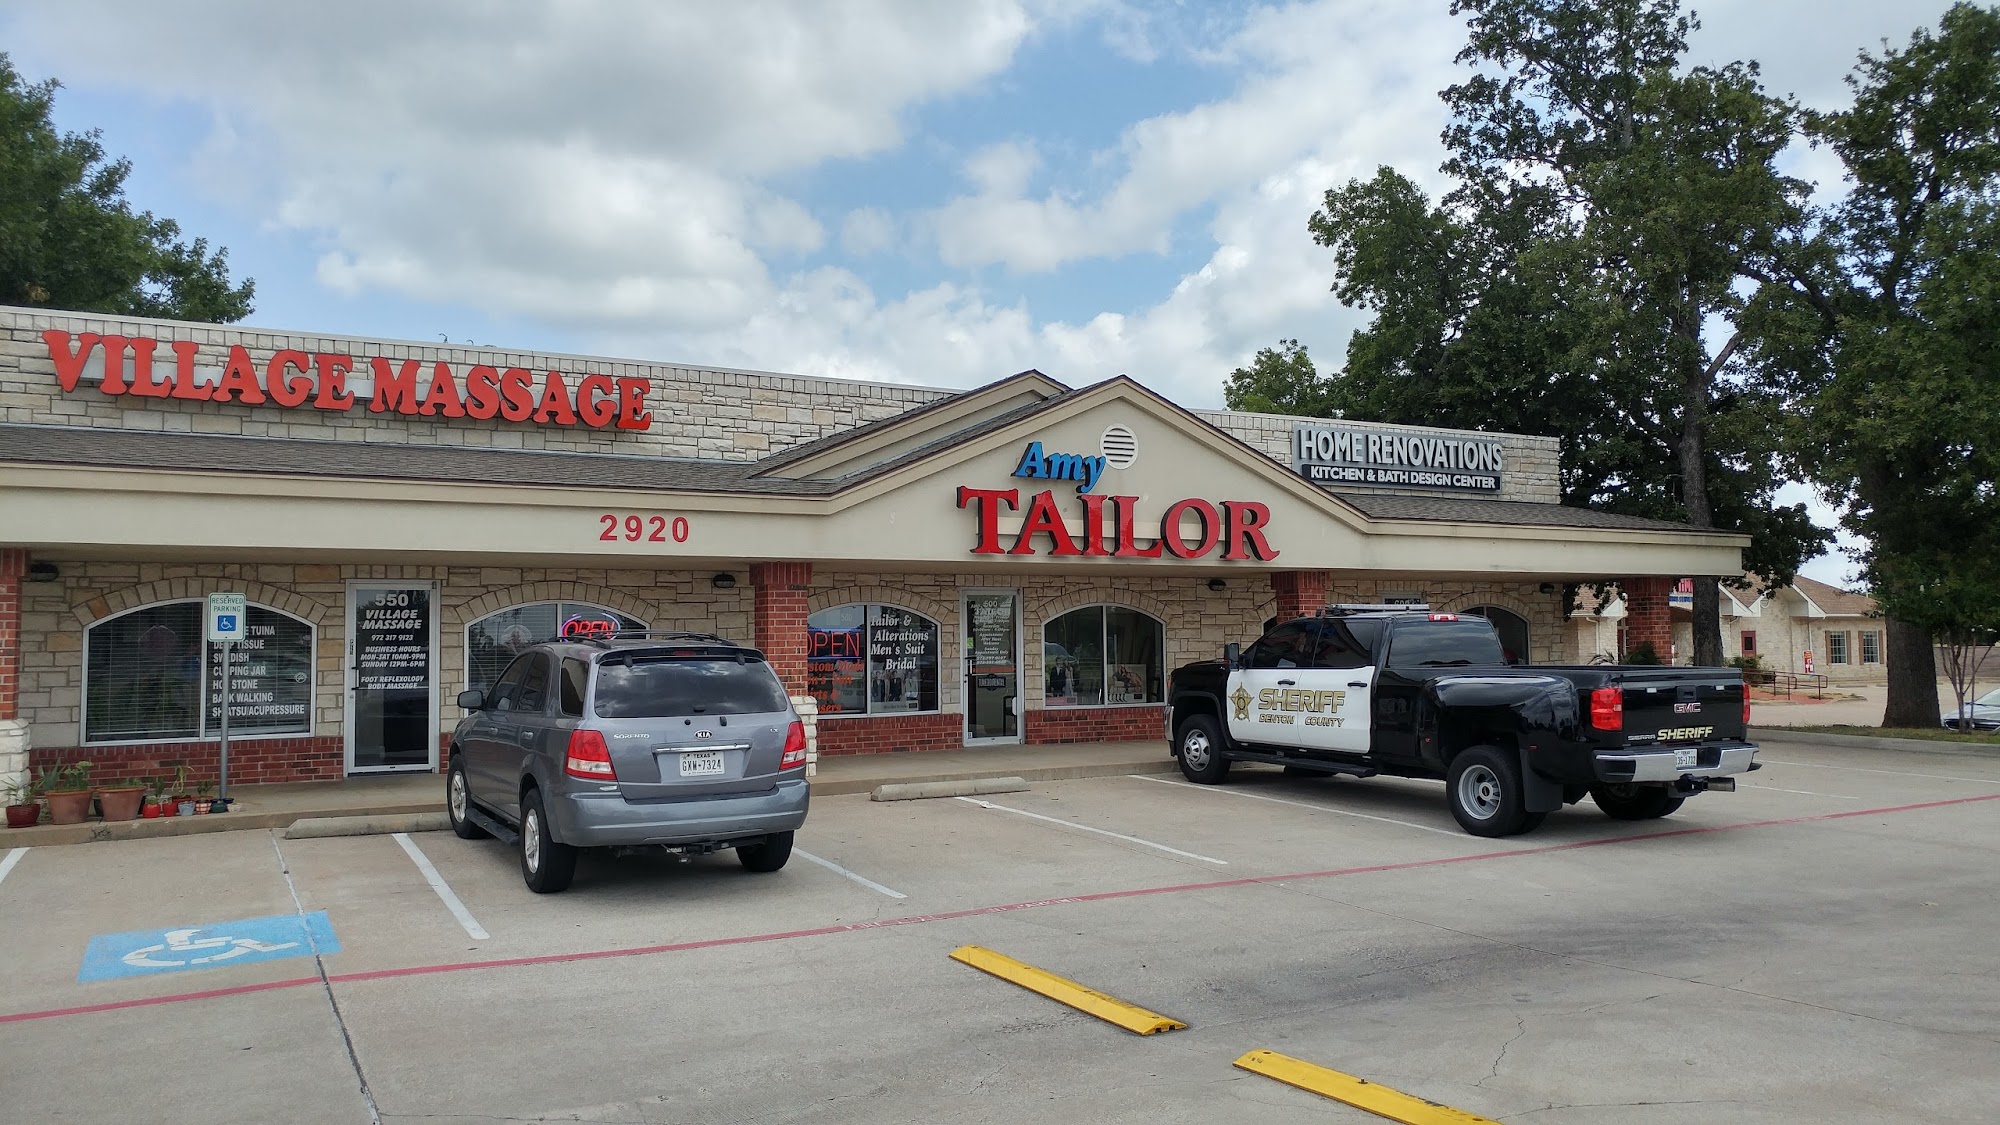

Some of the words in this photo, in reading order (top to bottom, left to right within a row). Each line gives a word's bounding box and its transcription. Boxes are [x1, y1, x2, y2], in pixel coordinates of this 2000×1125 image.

[42, 330, 354, 411] VILLAGE
[369, 357, 652, 430] MASSAGE
[1299, 429, 1364, 462] HOME
[1367, 434, 1503, 471] RENOVATIONS
[1010, 441, 1106, 493] Amy
[1310, 466, 1365, 481] KITCHEN
[1366, 469, 1376, 481] &
[1377, 469, 1409, 483] BATH
[1410, 472, 1452, 486] DESIGN
[1453, 474, 1495, 489] CENTER
[600, 514, 689, 543] 2920
[957, 485, 1281, 561] TAILOR
[375, 594, 409, 606] 550
[365, 609, 418, 619] VILLAGE
[841, 614, 853, 622] 500
[870, 614, 900, 626] Tailor
[904, 614, 912, 626] &
[251, 625, 275, 635] TUINA
[362, 619, 422, 630] MASSAGE
[873, 628, 929, 642] Alterations
[213, 641, 236, 649] DEP
[237, 640, 265, 649] TISSUE
[870, 643, 900, 656] Men's
[905, 642, 925, 655] Suit
[808, 661, 834, 672] stom
[885, 657, 917, 670] Bridal
[250, 666, 266, 676] JAR
[231, 680, 258, 689] STONE
[379, 675, 424, 683] REFLEXOLOGY
[212, 693, 235, 703] BAK
[236, 692, 273, 702] WALKING
[1258, 688, 1346, 713] SHERIFF
[1674, 702, 1701, 713] GMC
[1259, 713, 1295, 724] DENTON
[1305, 716, 1345, 727] COUNTY
[1657, 726, 1713, 740] SHERIFF
